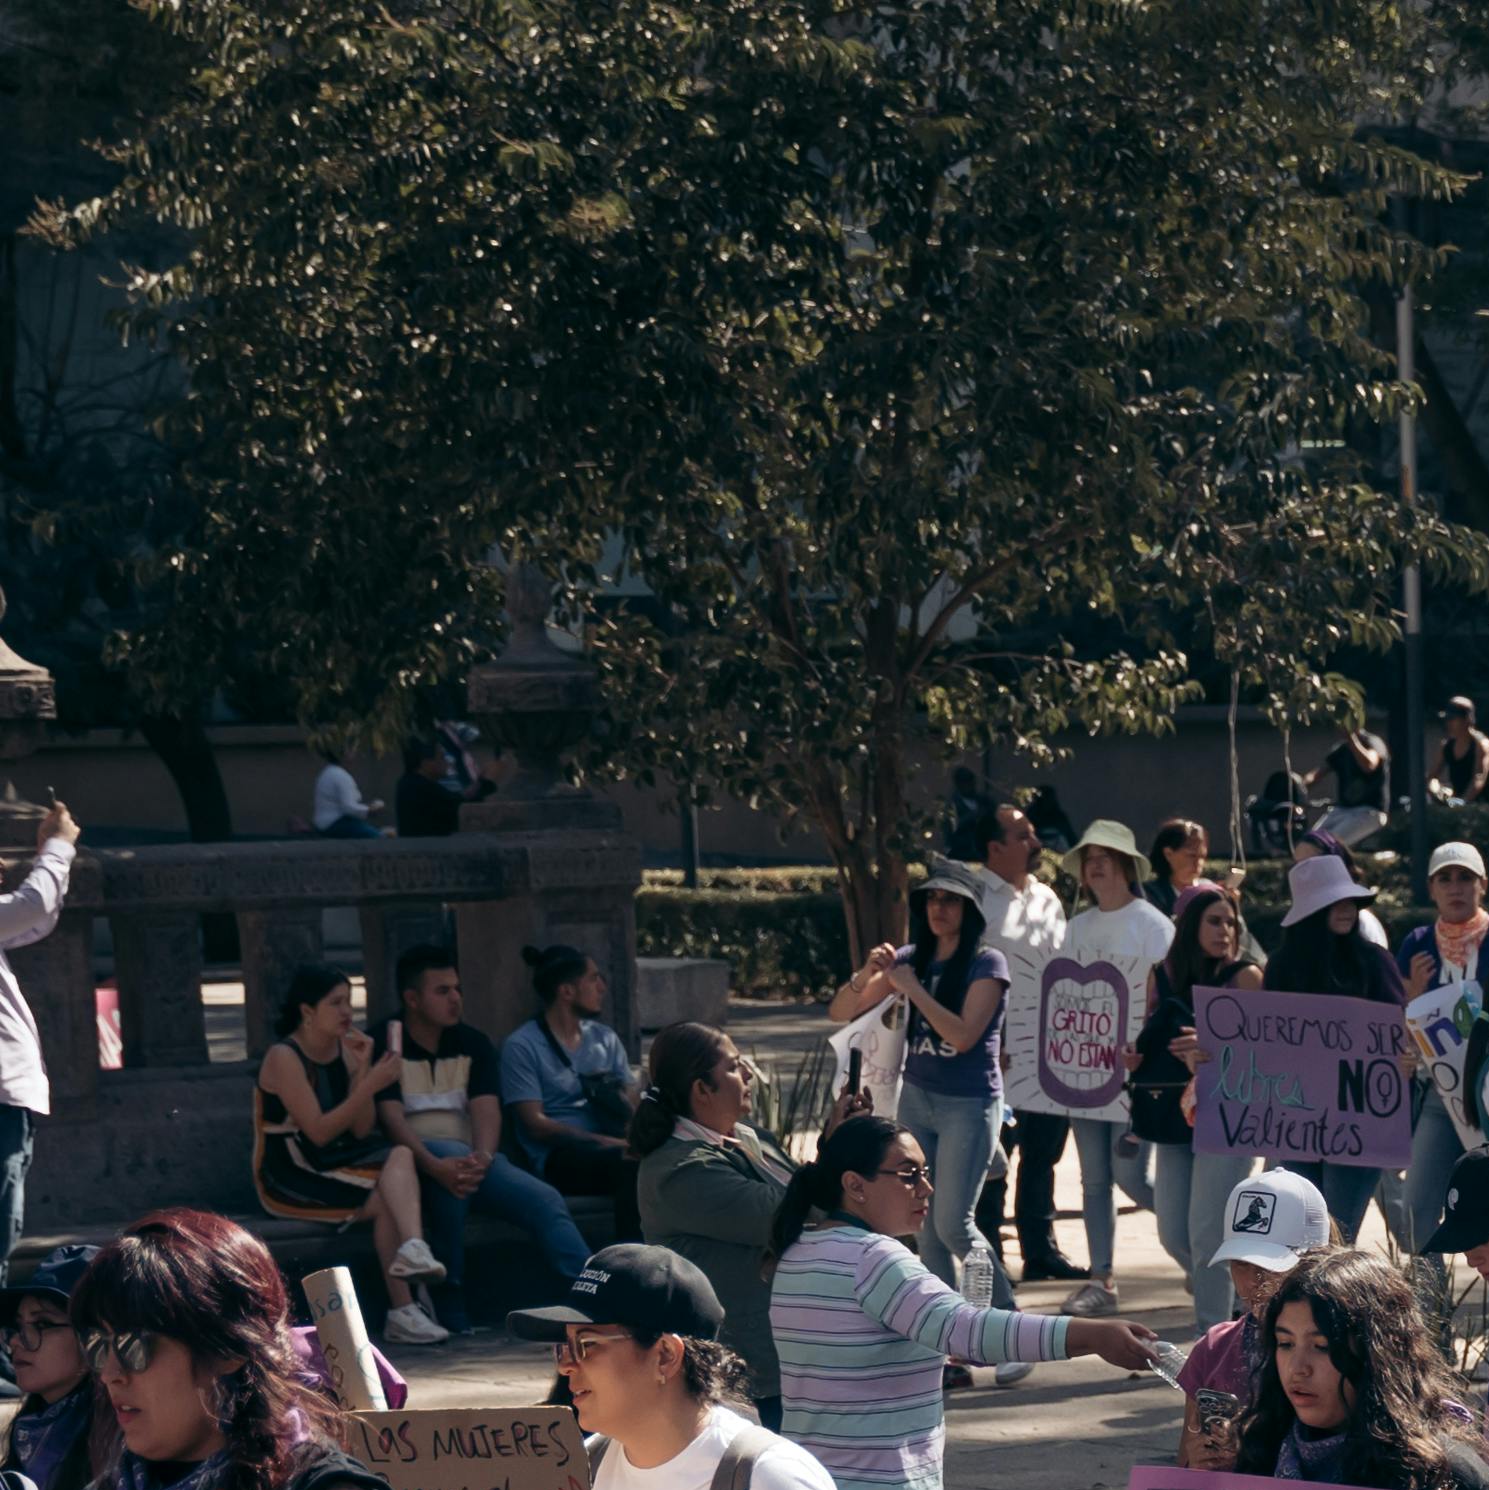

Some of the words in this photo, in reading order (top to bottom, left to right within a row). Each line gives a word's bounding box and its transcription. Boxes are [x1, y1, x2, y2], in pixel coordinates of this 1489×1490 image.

[1053, 1009, 1112, 1036] GRITO
[1048, 1039, 1074, 1065] NO
[1367, 1023, 1408, 1055] SER
[433, 1420, 570, 1467] MUJERES
